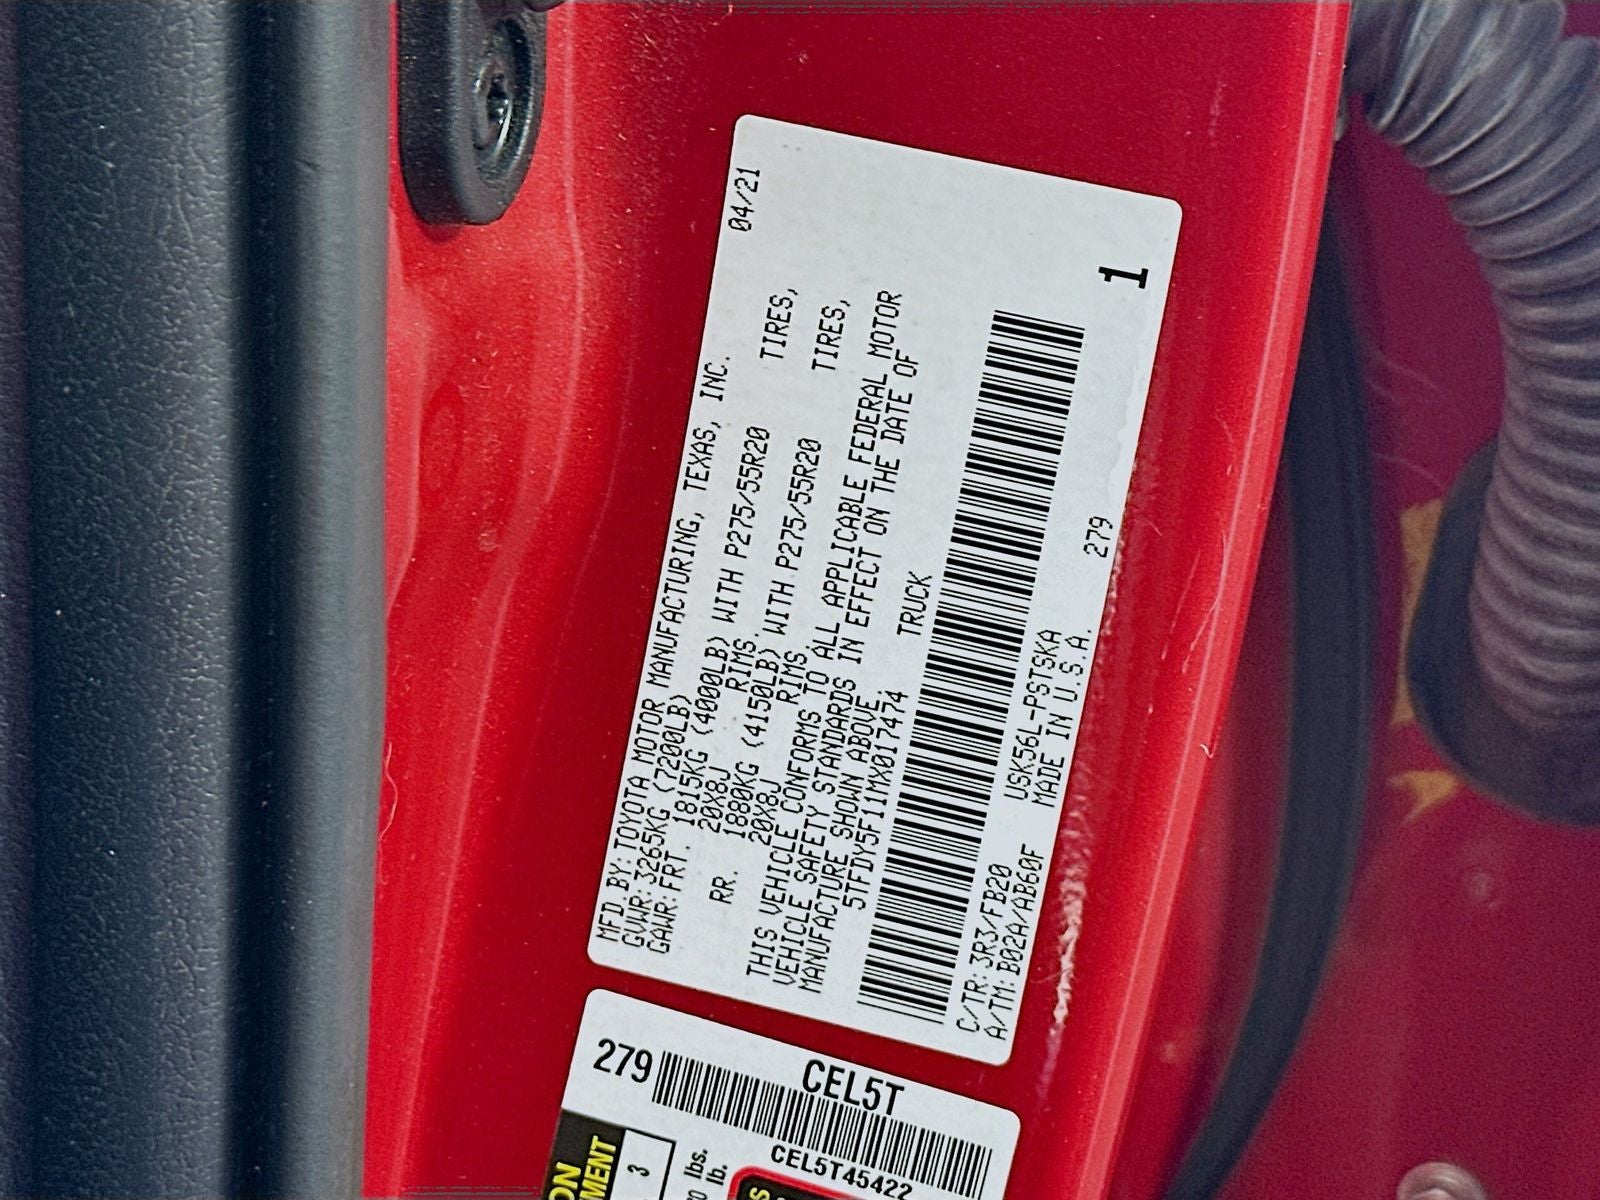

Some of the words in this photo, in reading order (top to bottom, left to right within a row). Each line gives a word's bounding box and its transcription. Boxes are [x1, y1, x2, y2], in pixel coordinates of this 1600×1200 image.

[727, 167, 761, 233] 04/21
[1098, 266, 1149, 290] 1
[759, 288, 799, 360] TIRES,
[810, 299, 851, 371] TIRES,
[866, 290, 903, 360] MOTOR
[699, 356, 731, 402] INC.
[892, 348, 919, 378] OF
[847, 373, 889, 466] FEDERAL
[879, 388, 913, 445] DATE
[682, 421, 722, 492] TEXAS,
[869, 454, 901, 494] THE
[723, 426, 771, 559] P275/55R20
[774, 437, 822, 571] P275/55R20
[862, 506, 891, 536] ON
[820, 474, 869, 609] APPLICABLE
[1082, 515, 1114, 559] 279
[645, 512, 705, 689] MANUFACTURING,
[711, 567, 745, 624] WITH
[761, 579, 796, 636] WITH
[844, 545, 883, 628] EFFECT
[810, 622, 841, 661] ALL
[837, 637, 865, 665] IN
[1052, 629, 1092, 703] U.S.A.
[690, 636, 731, 736] (4000LB)
[740, 648, 782, 749] (4150LB)
[802, 670, 830, 696] TO
[1003, 629, 1063, 801] USK56L-PSTSKA
[630, 698, 666, 766] MOTOR
[652, 694, 693, 793] (7200LB)
[697, 765, 732, 834] 20X8J
[724, 633, 759, 694] RIMS.
[747, 778, 782, 847] 20X8J
[775, 645, 811, 706] RIMS.
[779, 708, 822, 815] CONFORMS
[811, 676, 857, 796] STANDARDS
[841, 690, 909, 911] 5TFDY5F11MX017474
[896, 570, 933, 636] TRUCK
[845, 690, 883, 764] ABOVE.
[1045, 712, 1074, 741] IN
[672, 748, 709, 827] 1815KG
[722, 761, 760, 839] 1880KG
[828, 772, 865, 840] SHOWN
[1031, 752, 1066, 808] MADE
[758, 823, 799, 916] VEHICLE
[793, 804, 831, 885] SAFETY
[708, 871, 739, 905] RR.
[797, 849, 849, 994] MANUFACTURE
[745, 926, 778, 977] THIS
[771, 894, 813, 986] VEHICLE
[593, 1038, 654, 1083] 279
[802, 1059, 905, 1116] CEL5T
[626, 1164, 650, 1177] 3
[684, 1149, 708, 1179] lbs.
[706, 1165, 728, 1186] lb.
[771, 1144, 913, 1200] CEL5T45422
